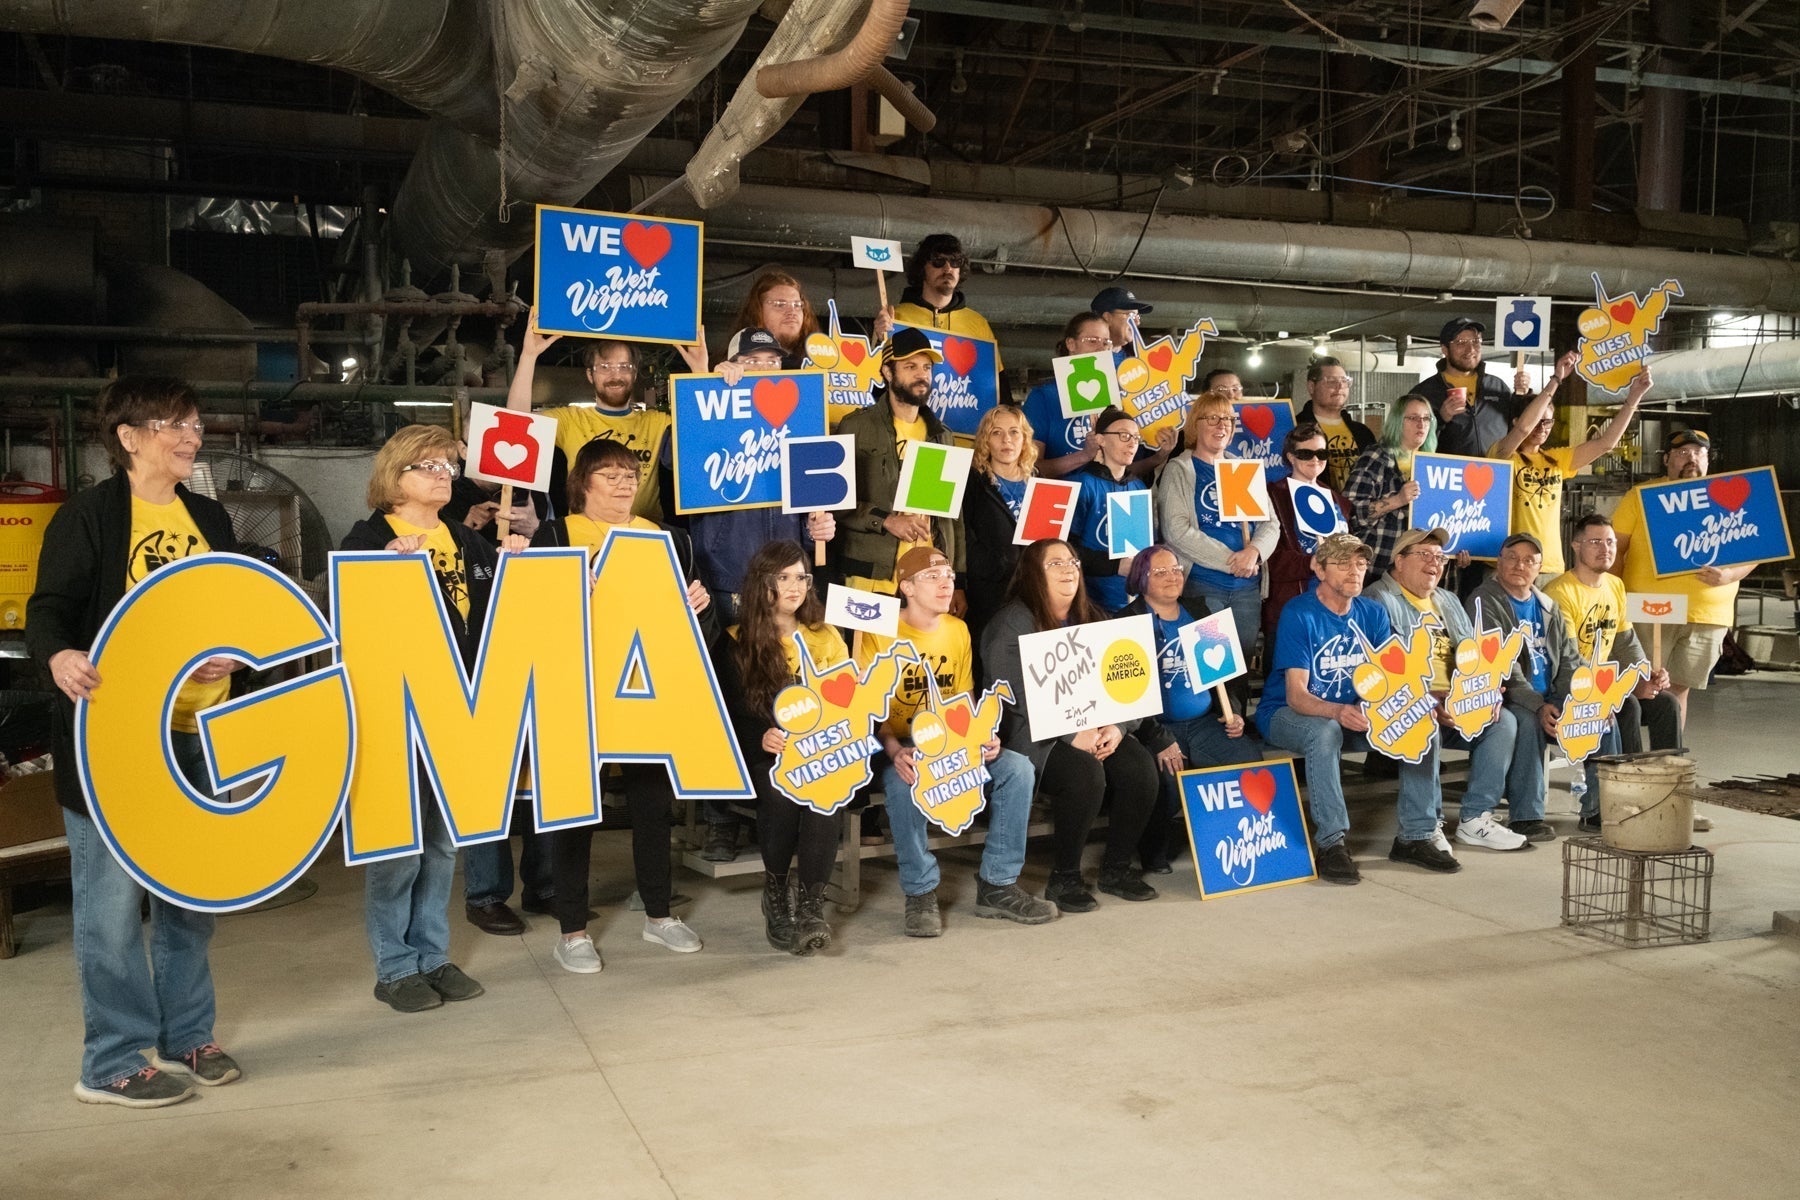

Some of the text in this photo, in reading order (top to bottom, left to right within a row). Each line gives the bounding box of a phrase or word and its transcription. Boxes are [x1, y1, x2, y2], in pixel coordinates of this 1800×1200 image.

[561, 222, 620, 256] WE
[605, 265, 661, 291] West
[566, 279, 668, 331] Virginia
[1579, 316, 1609, 333] GMA
[807, 344, 838, 357] GMA
[1592, 332, 1632, 357] WEST
[1585, 343, 1654, 376] VIRGINIA
[828, 372, 857, 387] EST
[935, 373, 971, 394] West
[1118, 365, 1146, 386] GMA
[694, 388, 752, 421] WE
[1131, 381, 1171, 411] WEST
[1134, 391, 1193, 430] IRGINIA
[739, 424, 791, 457] West
[1238, 437, 1273, 459] West
[704, 448, 781, 503] Virgin
[789, 441, 848, 508] B
[905, 446, 956, 513] L
[1426, 465, 1463, 491] WE
[1219, 463, 1265, 517] K
[1658, 487, 1710, 514] WE
[0, 517, 32, 526] LOO
[1021, 483, 1072, 541] E
[1111, 493, 1151, 554] N
[1295, 485, 1337, 534] O
[1452, 499, 1487, 520] West
[1702, 507, 1748, 534] West
[1673, 523, 1759, 567] Virginia
[1028, 627, 1086, 688] LOOK
[1108, 659, 1140, 671] MORNING
[1113, 653, 1134, 663] GOOD
[1320, 653, 1366, 669] BLENK
[1457, 648, 1478, 664] GMA
[1055, 646, 1096, 705] MOM!
[1106, 667, 1146, 682] AMERICA
[1356, 670, 1384, 695] GMA
[1461, 673, 1491, 695] WEST
[778, 697, 818, 722] GMA
[1065, 706, 1082, 719] I'M
[1376, 683, 1414, 721] WEST
[1452, 688, 1503, 716] VIRGINIA
[1572, 703, 1602, 720] WEST
[74, 528, 757, 913] GMA
[914, 722, 944, 744] GMA
[1076, 717, 1087, 727] ON
[1377, 692, 1439, 747] VIRGINIA
[1562, 719, 1611, 740] VIRGINIA
[794, 719, 852, 759] WEST
[785, 734, 884, 789] VIRGINIA
[928, 748, 970, 780] WEST
[922, 765, 992, 808] VIRGINIA
[1197, 780, 1244, 812] WE
[1237, 811, 1276, 842] West
[1215, 831, 1288, 886] Virginia
